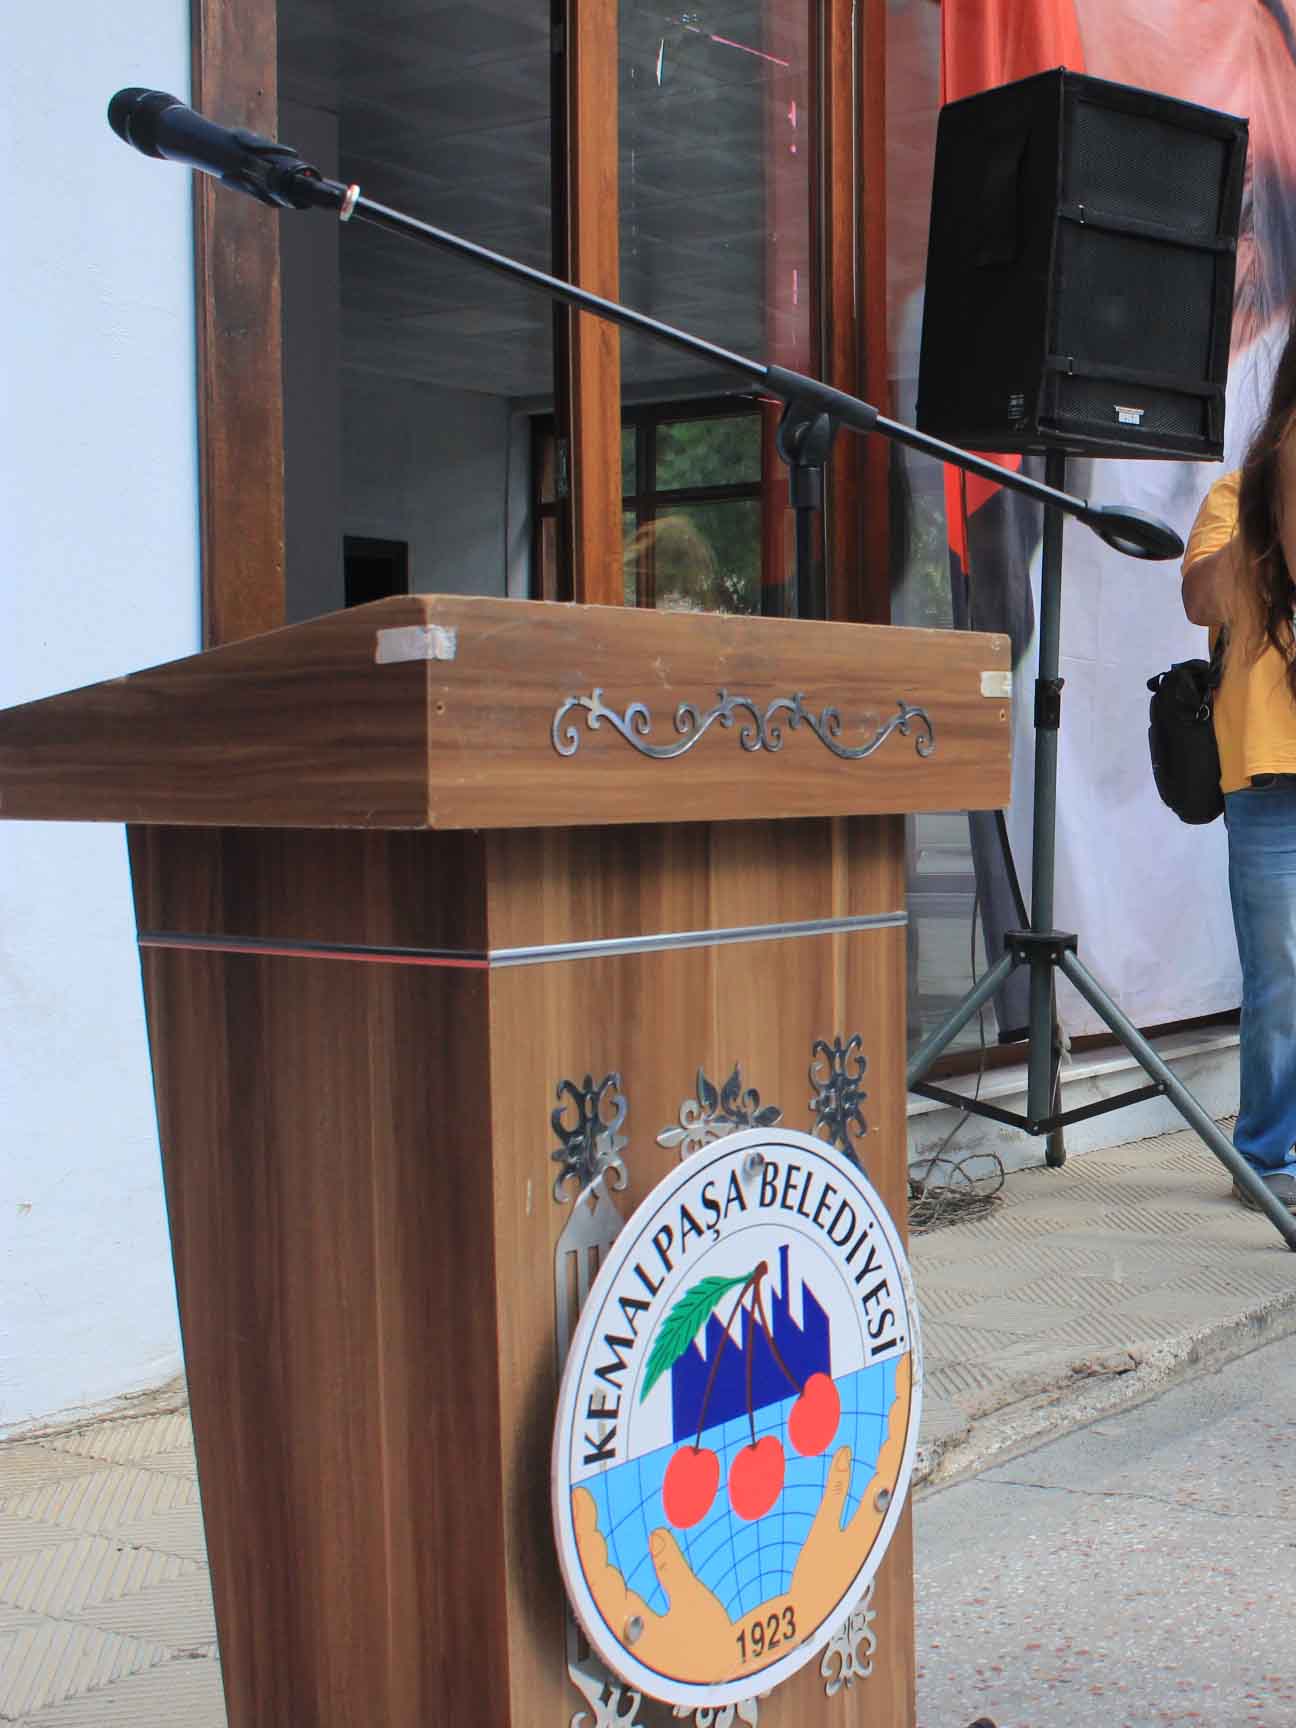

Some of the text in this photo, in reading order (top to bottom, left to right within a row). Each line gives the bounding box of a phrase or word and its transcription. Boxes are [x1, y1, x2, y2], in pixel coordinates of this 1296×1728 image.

[583, 1160, 905, 1466] KEMALPAŞA BELEDİYESİ
[736, 1605, 796, 1665] 1923
